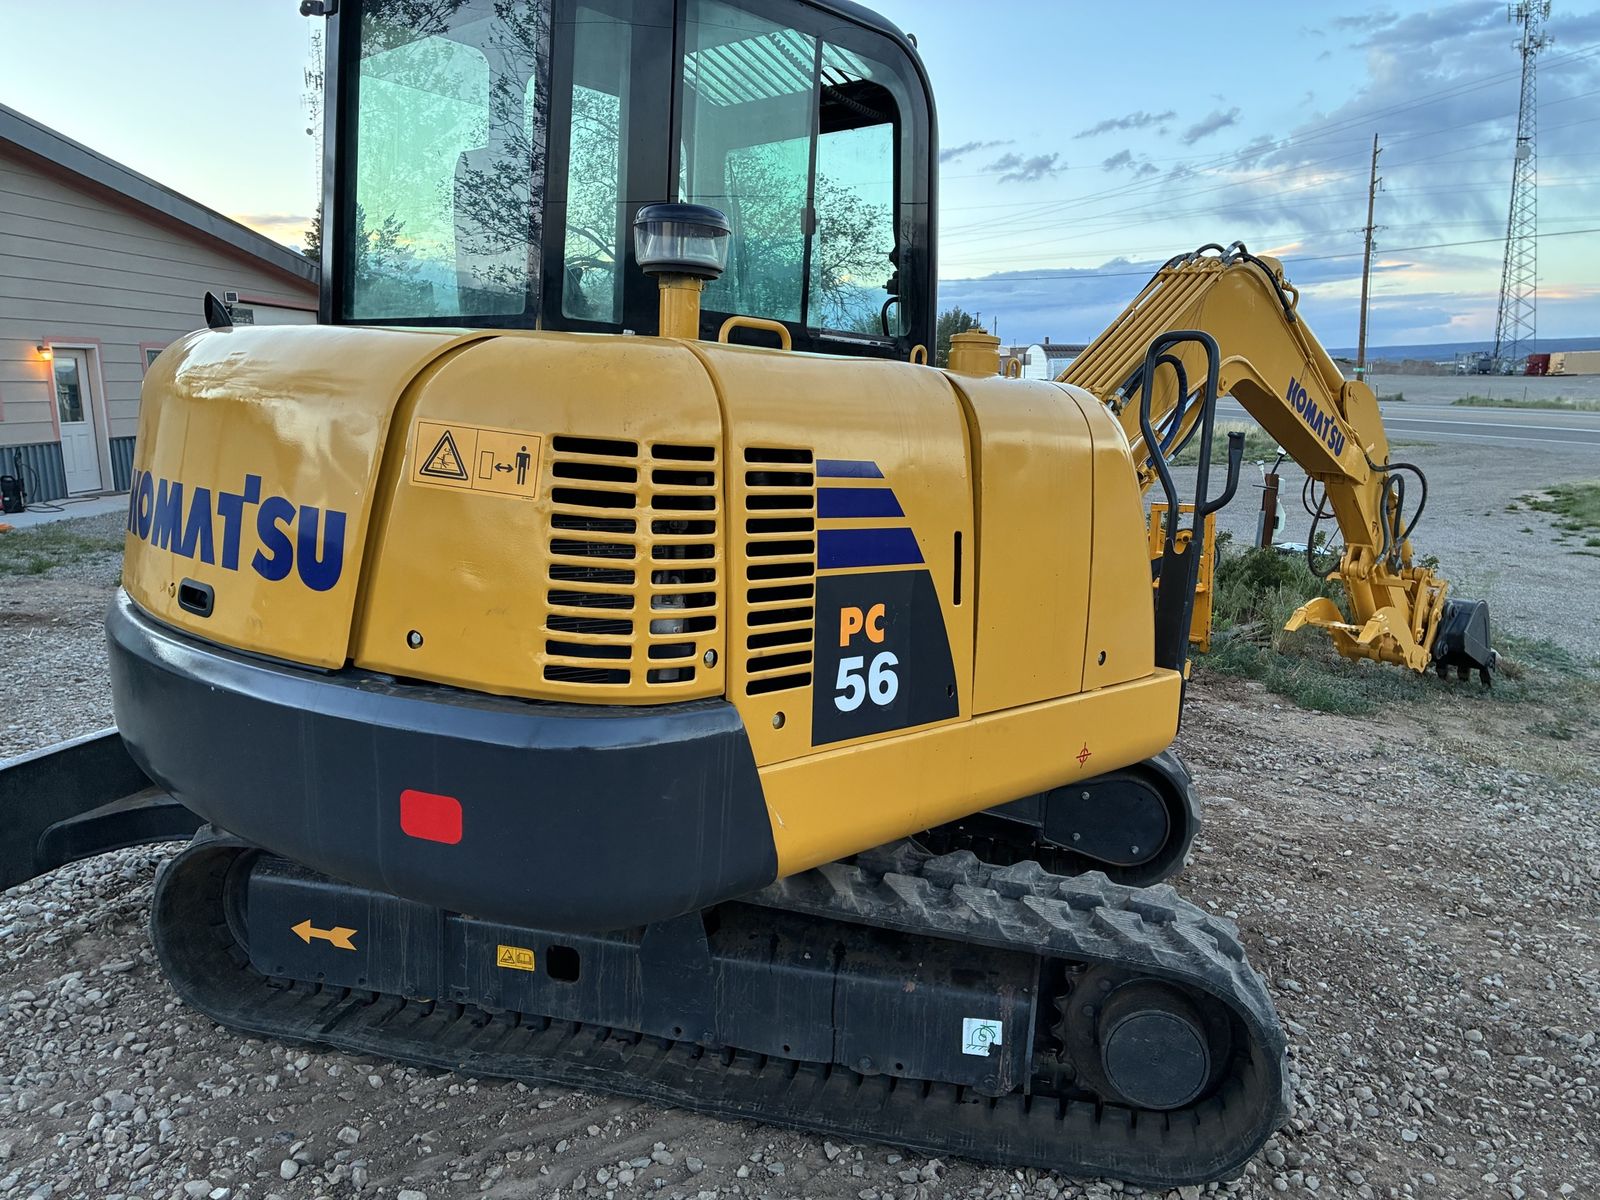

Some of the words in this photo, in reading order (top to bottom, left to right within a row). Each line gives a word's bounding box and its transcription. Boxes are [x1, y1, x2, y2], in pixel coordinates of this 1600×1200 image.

[1286, 376, 1346, 457] KOMATSU
[839, 603, 885, 647] PC
[834, 651, 899, 712] 56
